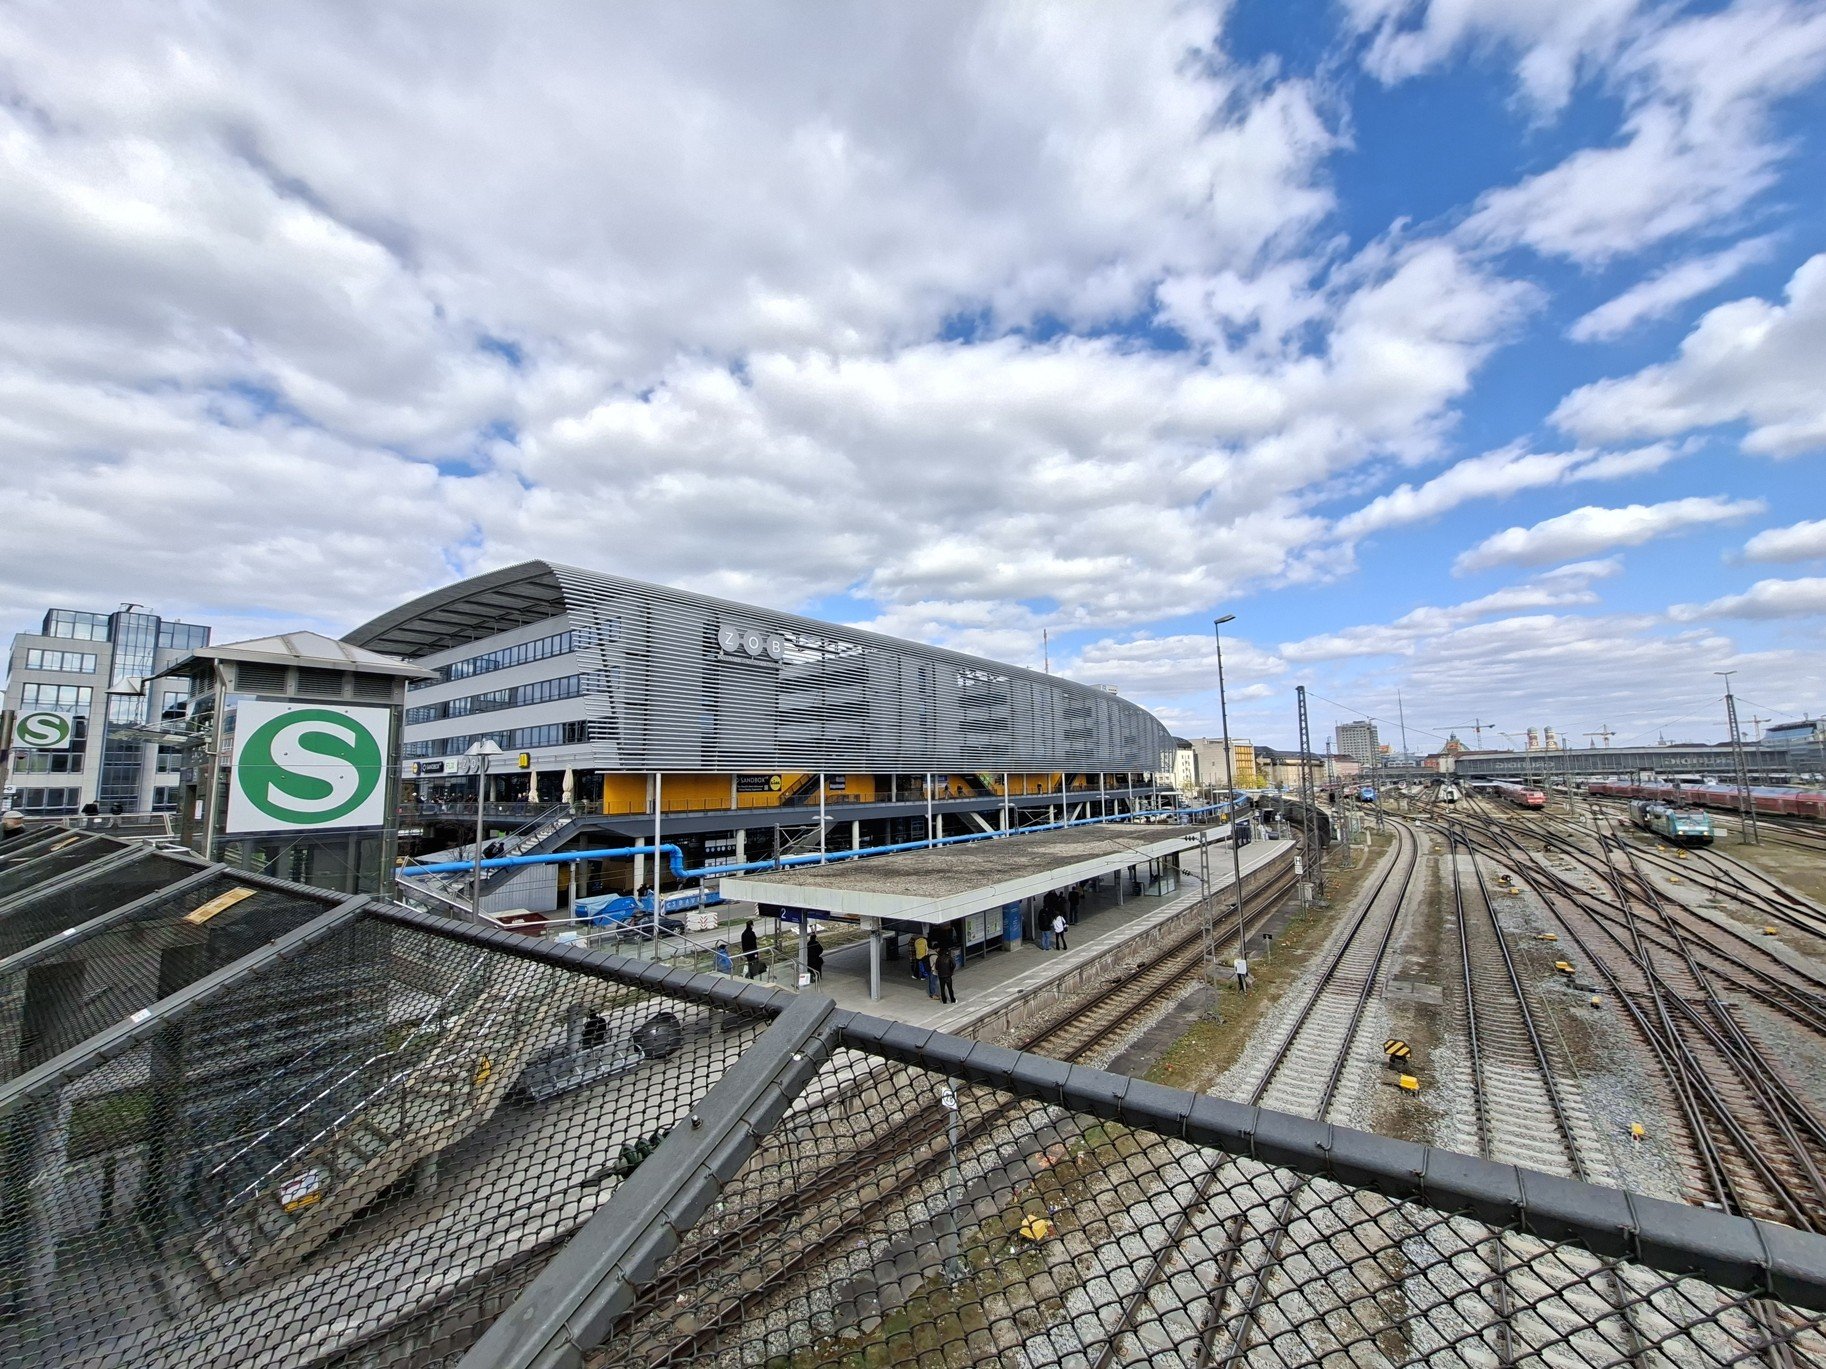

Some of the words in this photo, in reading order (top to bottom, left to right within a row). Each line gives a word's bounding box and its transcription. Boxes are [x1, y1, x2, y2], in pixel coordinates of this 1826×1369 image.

[724, 631, 781, 653] ZOB
[24, 714, 61, 745] S
[267, 720, 360, 813] S
[780, 907, 787, 919] 2
